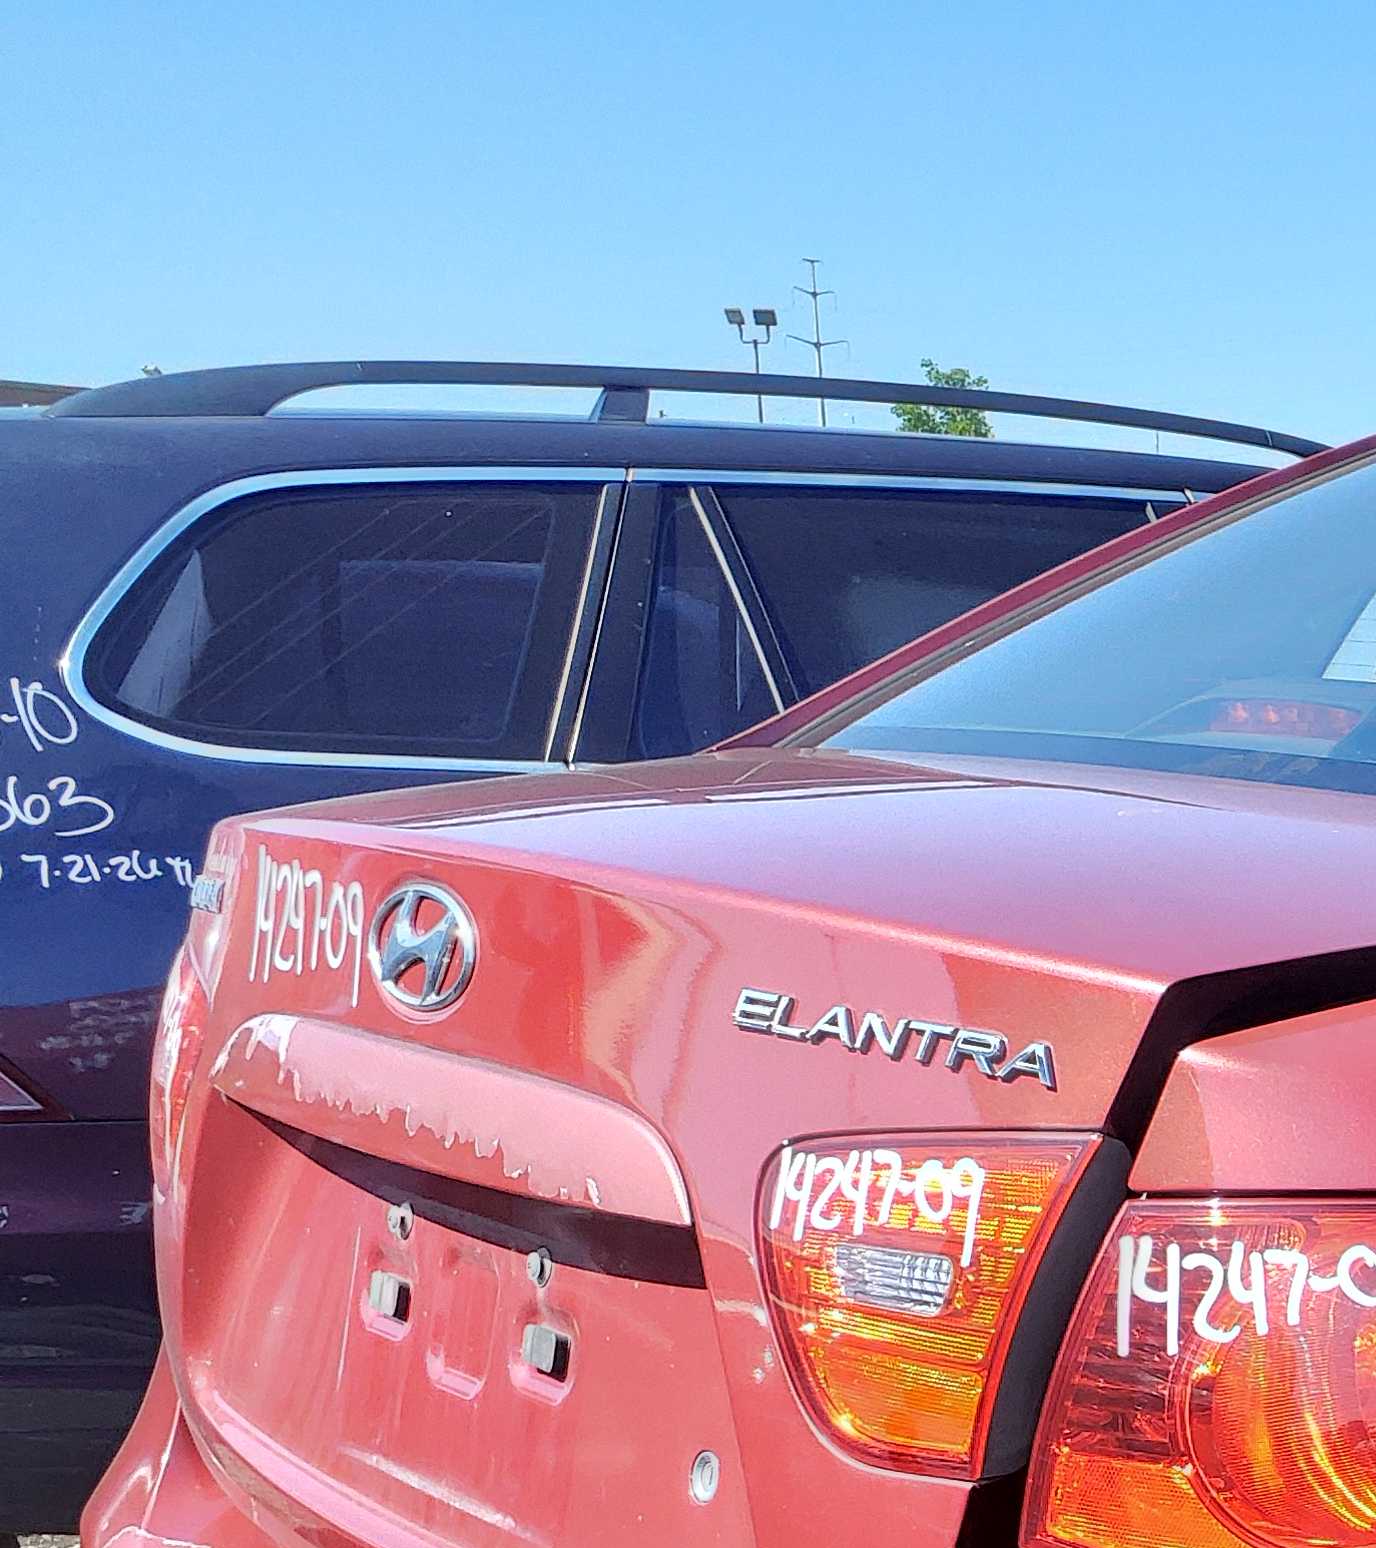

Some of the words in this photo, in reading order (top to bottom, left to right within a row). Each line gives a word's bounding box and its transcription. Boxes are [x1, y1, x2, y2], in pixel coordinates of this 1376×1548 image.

[248, 844, 364, 1008] 14247-09
[732, 986, 1057, 1092] ELANTRA
[768, 1147, 986, 1268] 14247-09
